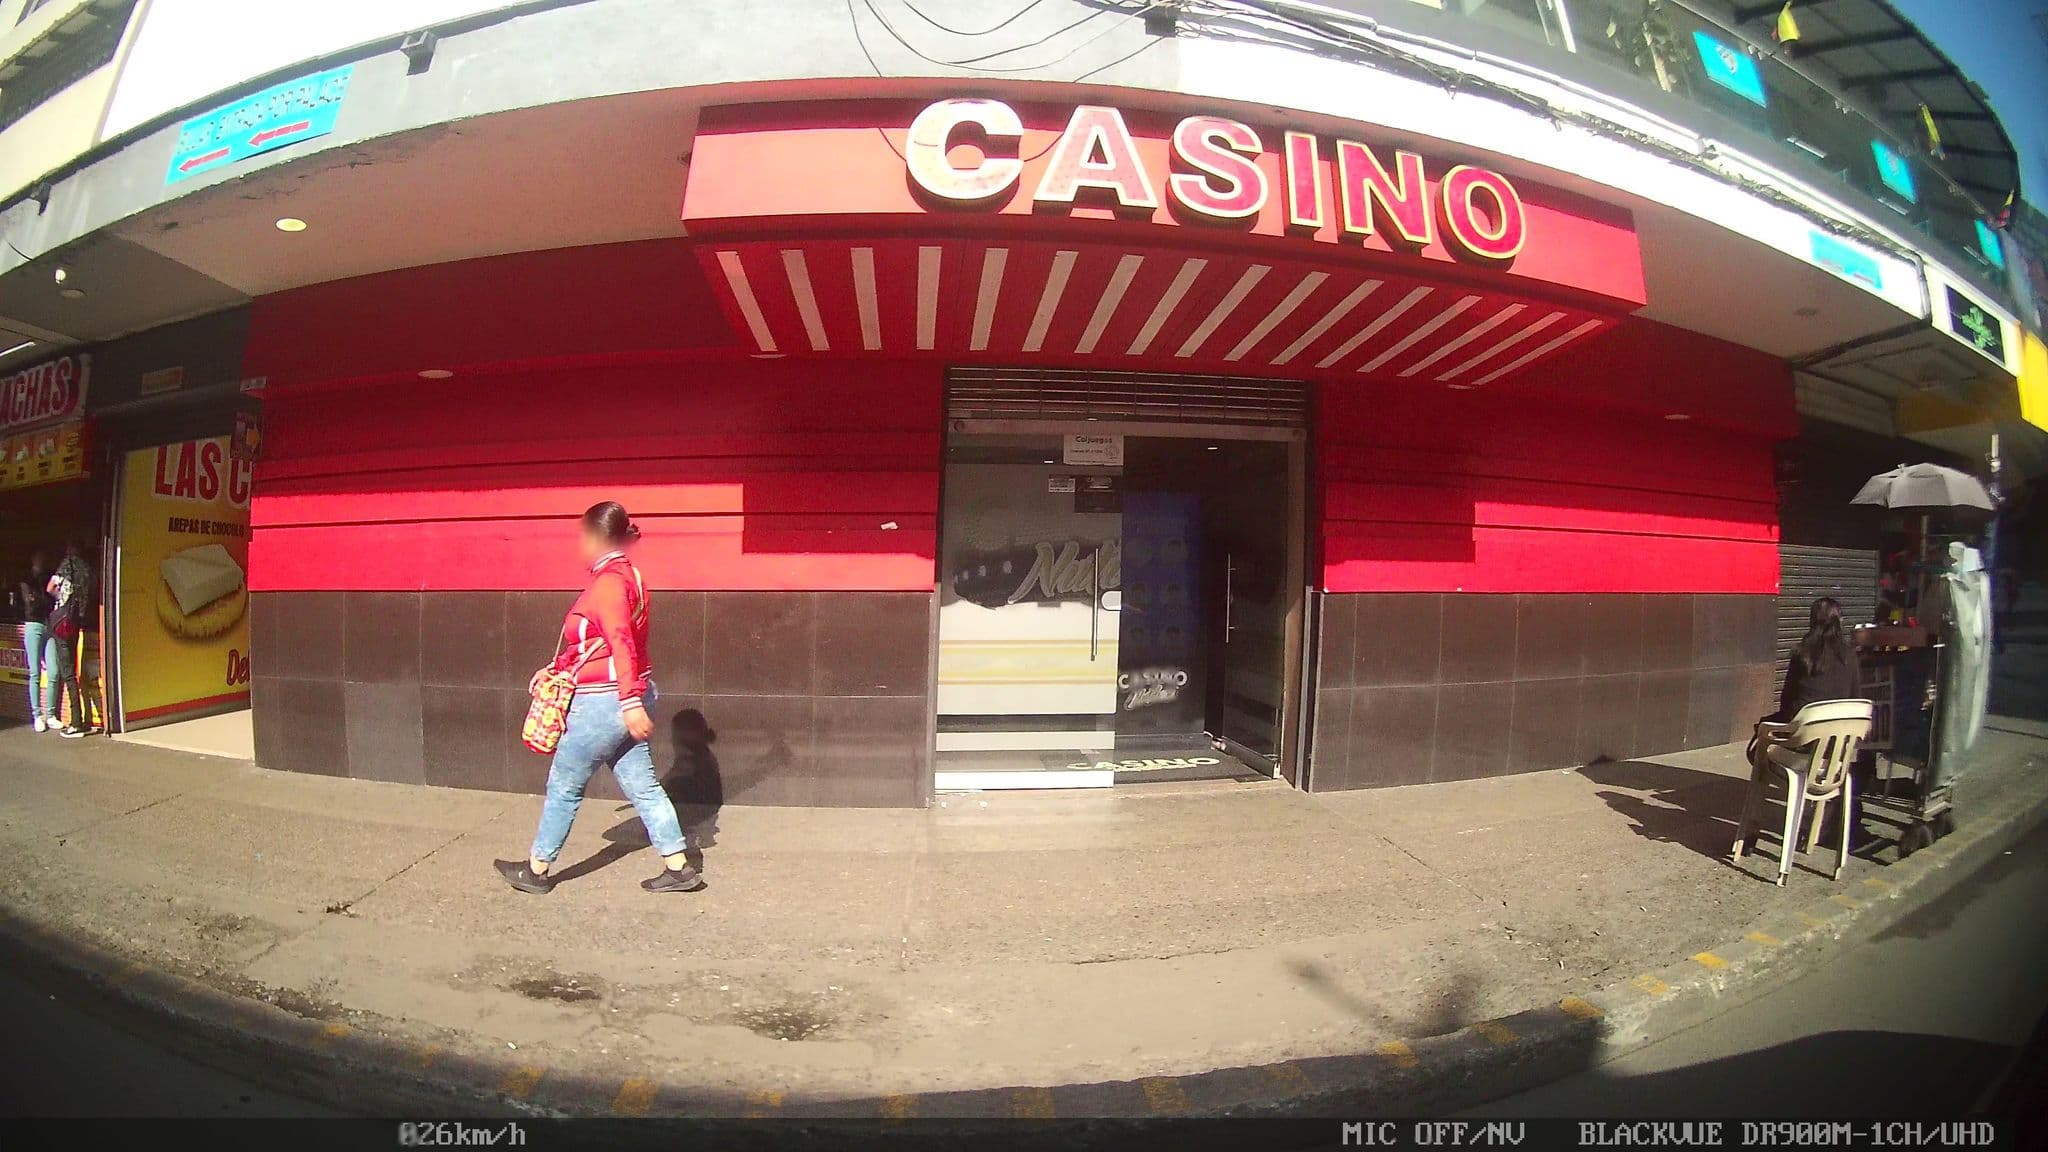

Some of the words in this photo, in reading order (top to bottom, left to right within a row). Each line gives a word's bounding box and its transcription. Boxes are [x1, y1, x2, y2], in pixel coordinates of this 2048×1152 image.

[906, 98, 1527, 260] CASINO
[155, 440, 222, 501] LAS
[168, 516, 200, 534] AREPAS
[200, 520, 211, 535] DE
[1067, 756, 1220, 771] CASINO
